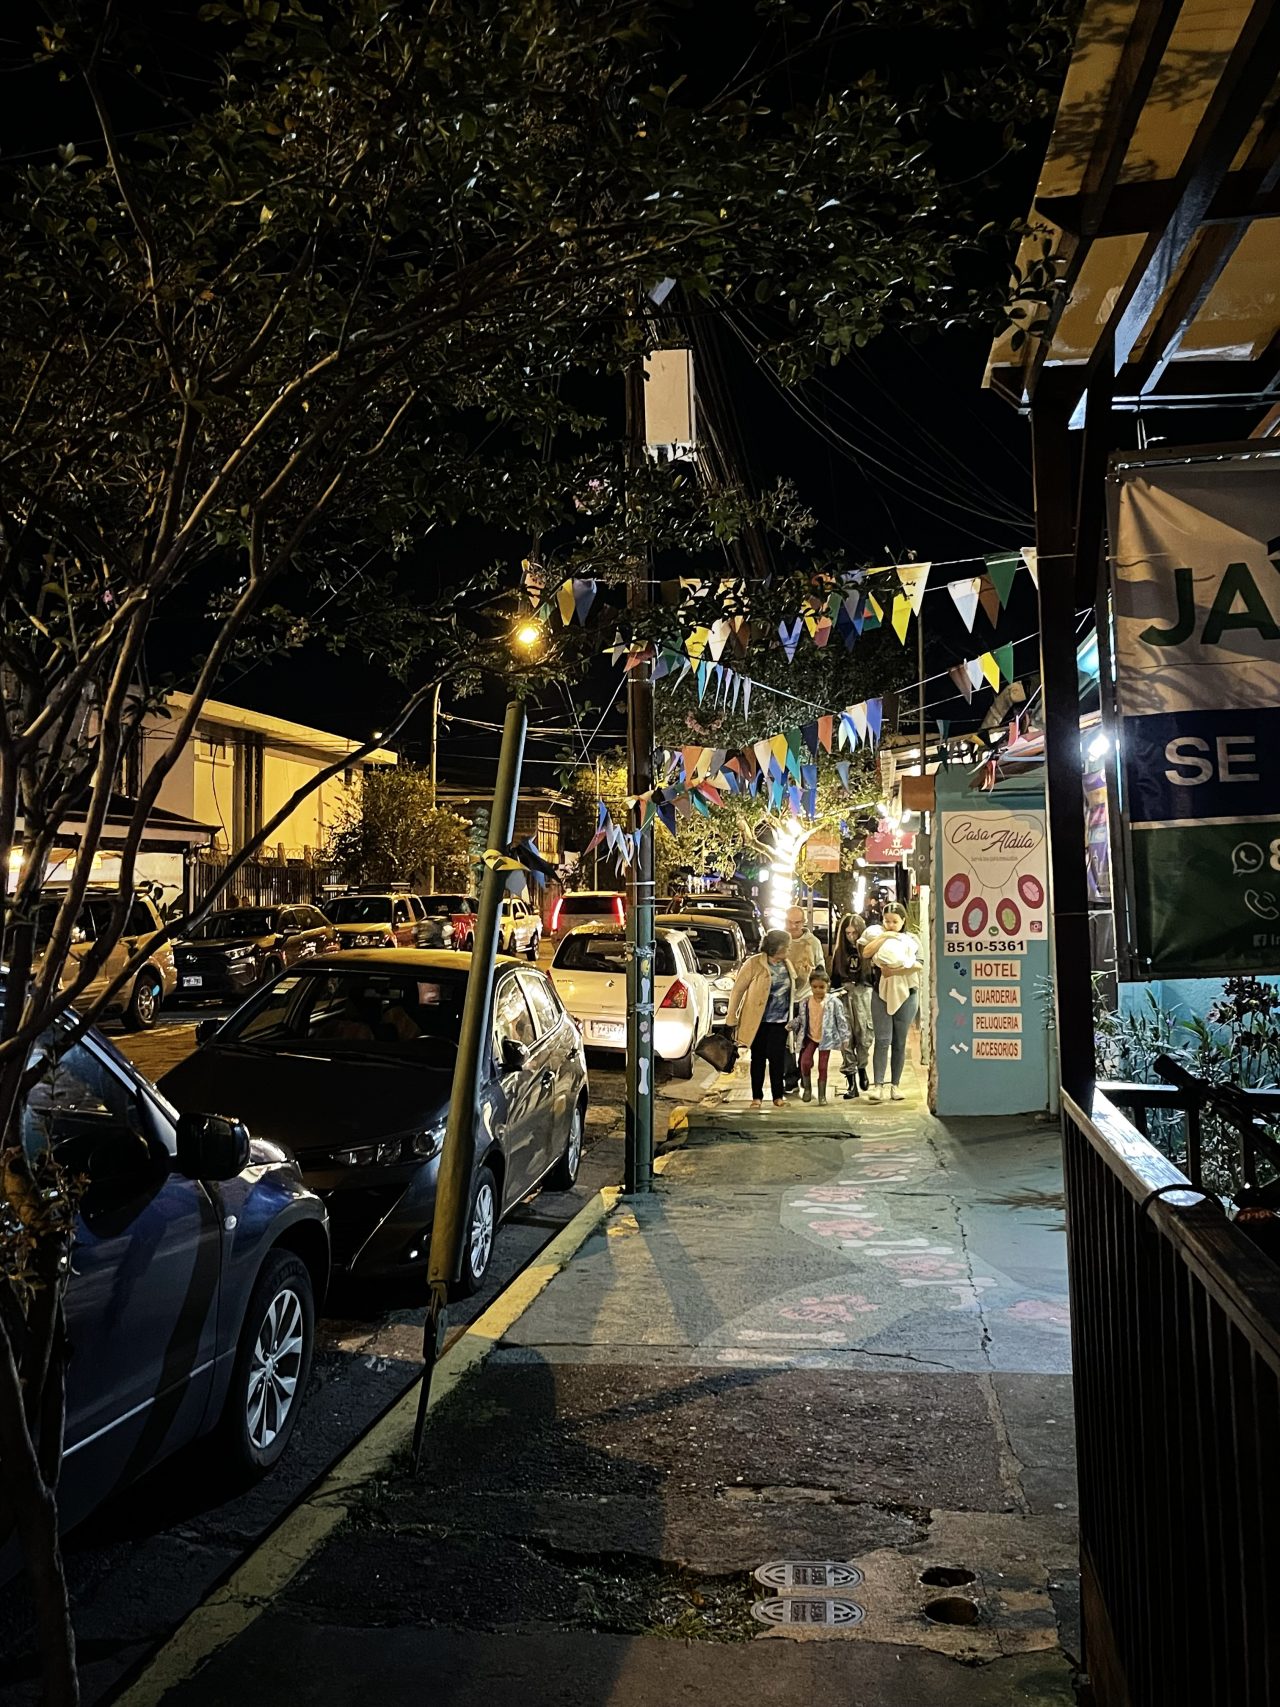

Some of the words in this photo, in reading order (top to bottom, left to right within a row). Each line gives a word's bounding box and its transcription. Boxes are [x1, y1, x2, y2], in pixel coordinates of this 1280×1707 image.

[1139, 560, 1280, 647] JA
[1164, 735, 1260, 786] SE
[951, 821, 990, 844] Casa
[981, 829, 1034, 853] Aldila
[947, 940, 1024, 953] 8510-5361
[974, 963, 1017, 977] HOTEL
[974, 989, 1018, 1004] GUARDERIA
[975, 1016, 1019, 1030] PELUQUERIA
[975, 1042, 1019, 1057] ACCESORIOS
